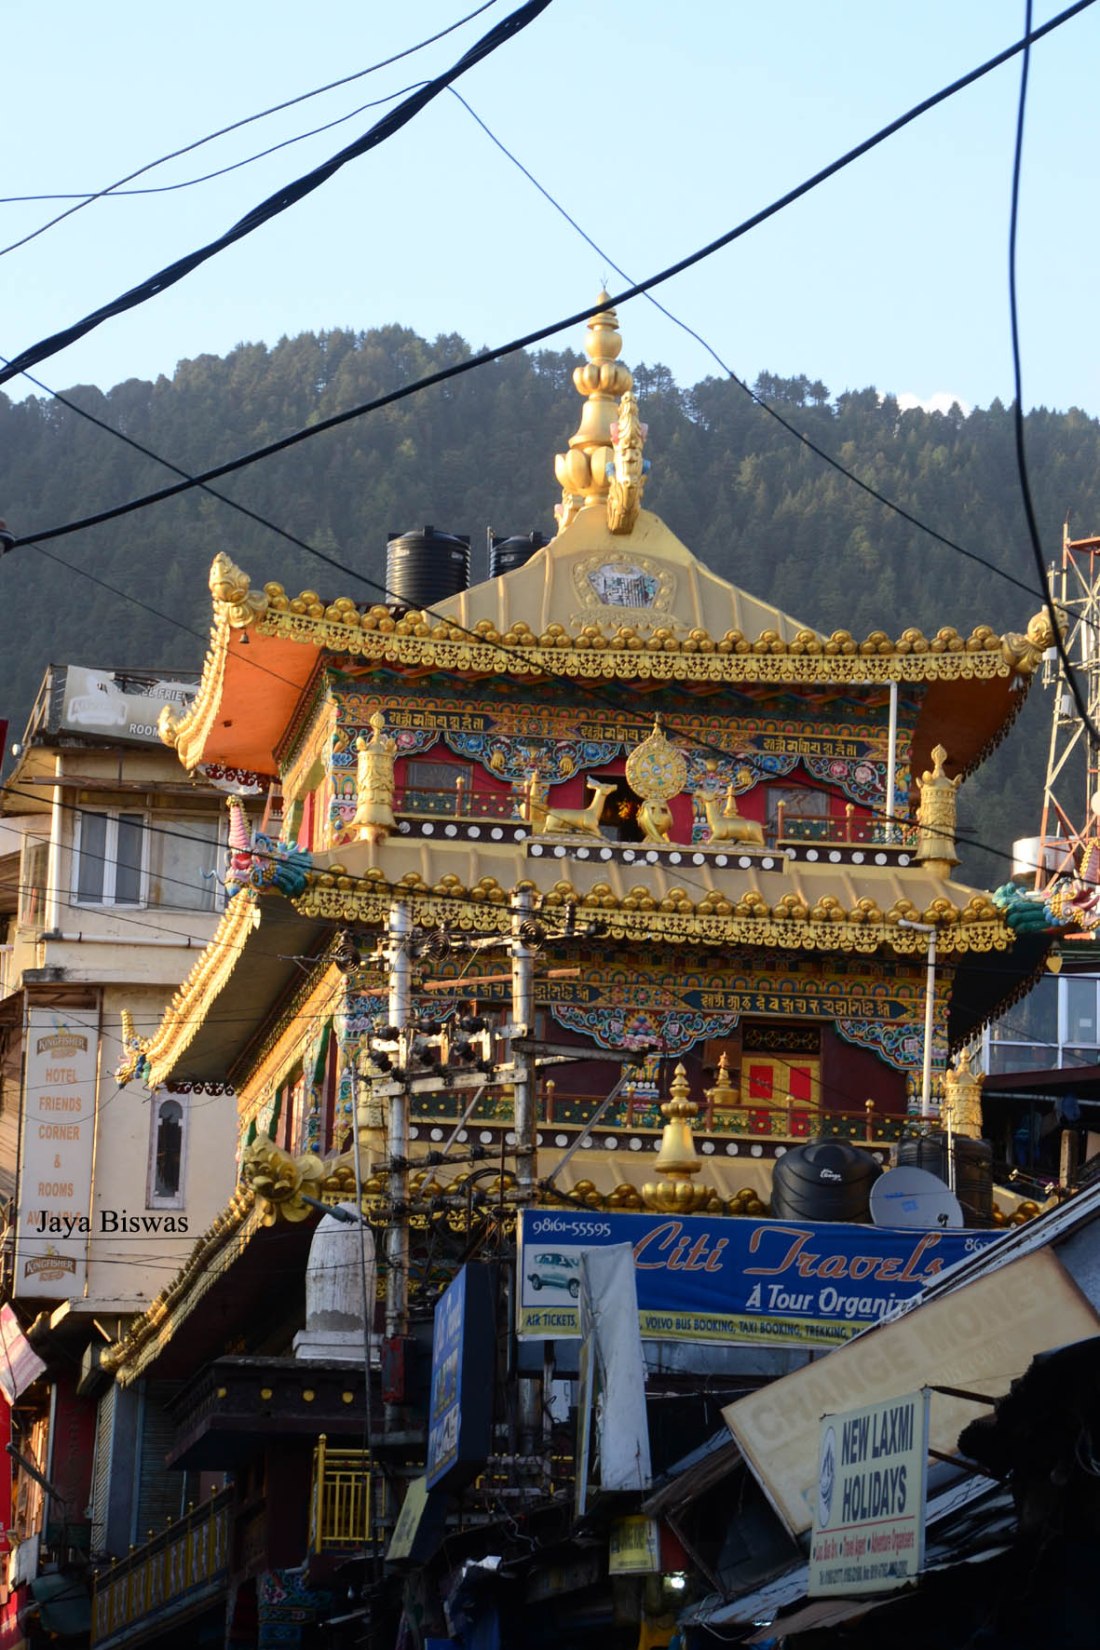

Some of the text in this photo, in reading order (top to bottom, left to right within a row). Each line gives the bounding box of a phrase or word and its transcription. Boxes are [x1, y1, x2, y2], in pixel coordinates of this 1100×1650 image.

[158, 687, 188, 702] FRIE
[45, 1067, 77, 1083] HOTEL
[39, 1096, 82, 1112] FRIENDS
[39, 1124, 80, 1140] CORNER
[38, 1182, 74, 1197] ROOMS
[532, 1217, 611, 1237] 98161-55595
[633, 1221, 945, 1282] Citi Travels
[745, 1281, 762, 1311] A
[767, 1284, 814, 1313] Tour
[526, 1313, 541, 1326] AIR
[645, 1316, 673, 1330] VOLVO
[676, 1318, 691, 1331] BUS
[739, 1321, 757, 1333] TAXI
[747, 1330, 918, 1447] CHANGE
[911, 1262, 1045, 1362] MONE
[842, 1403, 914, 1466] NEW LAXMI
[842, 1465, 907, 1523] HOLIDAYS
